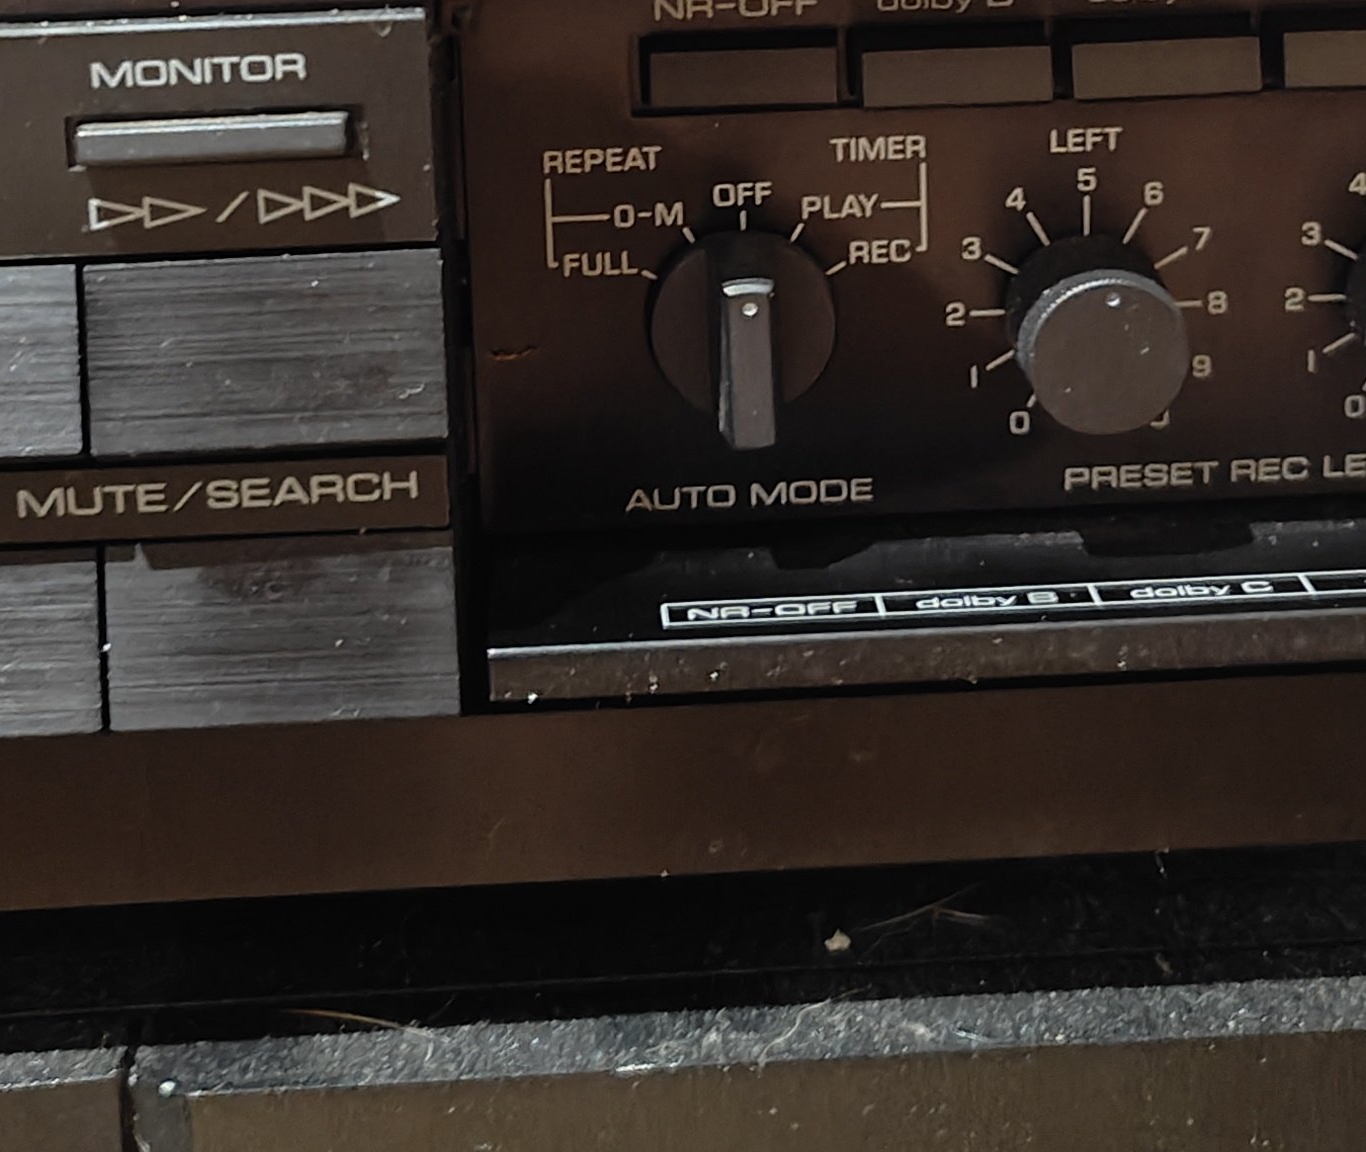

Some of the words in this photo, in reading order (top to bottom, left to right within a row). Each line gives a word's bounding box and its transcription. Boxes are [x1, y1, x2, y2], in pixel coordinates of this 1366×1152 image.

[90, 53, 309, 88] MONITOR
[830, 135, 926, 162] TIMER
[1049, 127, 1122, 153] LEFT
[543, 146, 661, 175] REPEAT
[1077, 168, 1097, 193] 5
[712, 181, 772, 207] OFF
[802, 193, 879, 220] PLAY
[1004, 186, 1027, 212] 4
[1143, 182, 1164, 206] 6
[1192, 227, 1214, 252] 7
[1301, 223, 1322, 246] 3
[848, 240, 911, 265] REC
[961, 238, 982, 261] 3
[562, 251, 639, 277] FULL
[1206, 291, 1227, 315] 8
[1284, 288, 1304, 311] 2
[945, 302, 966, 327] 2
[1064, 460, 1219, 491] PRESET
[1230, 456, 1309, 483] REC
[16, 470, 419, 520] MUTE/SEARCH
[626, 487, 736, 513] AUTO
[751, 478, 873, 504] MODE
[916, 591, 1017, 612] dolby
[1028, 589, 1058, 605] B
[1130, 581, 1231, 602] dolby
[1241, 578, 1273, 594] C
[686, 601, 857, 621] NR-OFF
